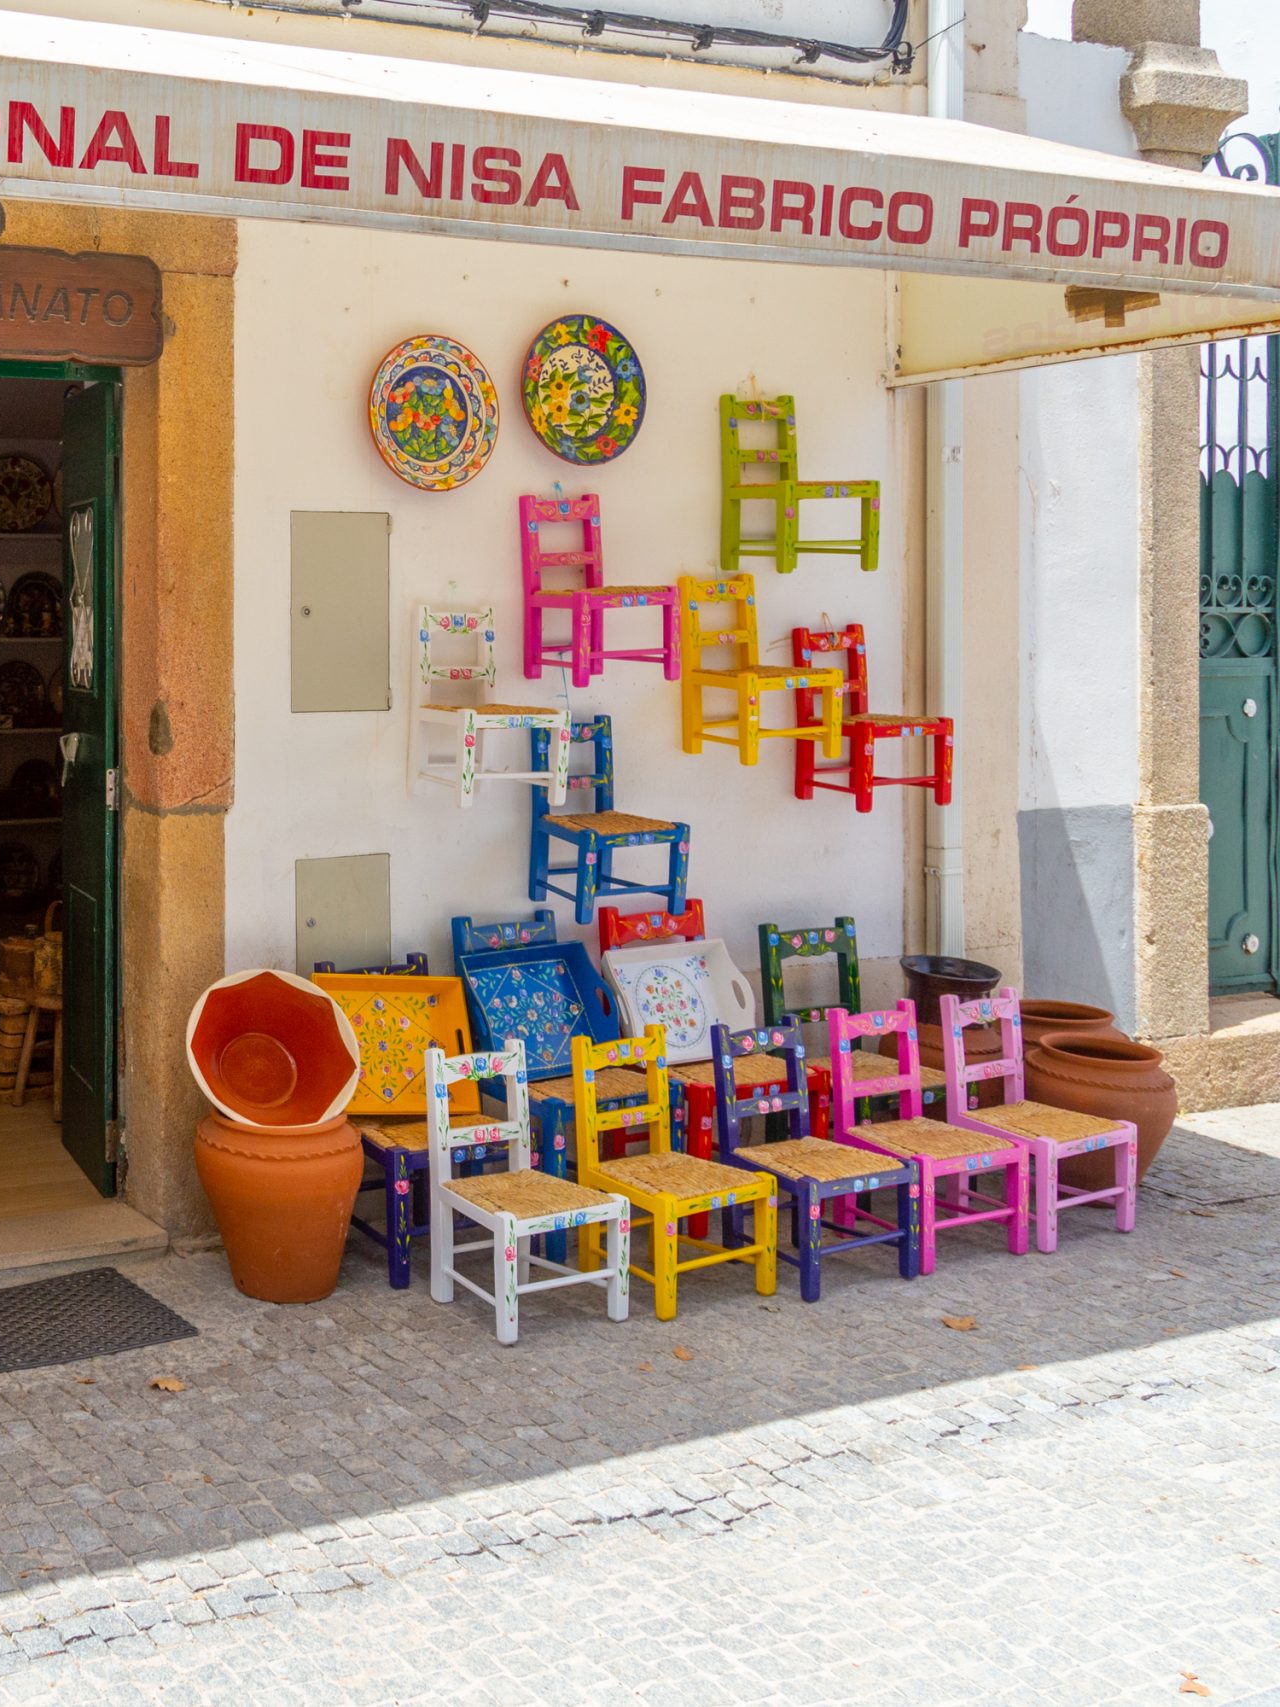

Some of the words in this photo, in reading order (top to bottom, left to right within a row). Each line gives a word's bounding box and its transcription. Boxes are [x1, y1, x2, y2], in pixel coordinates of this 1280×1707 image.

[233, 122, 352, 191] DE
[384, 137, 580, 211] NISA
[620, 165, 934, 245] FABRICO
[958, 194, 1230, 269] PRÓPRIO
